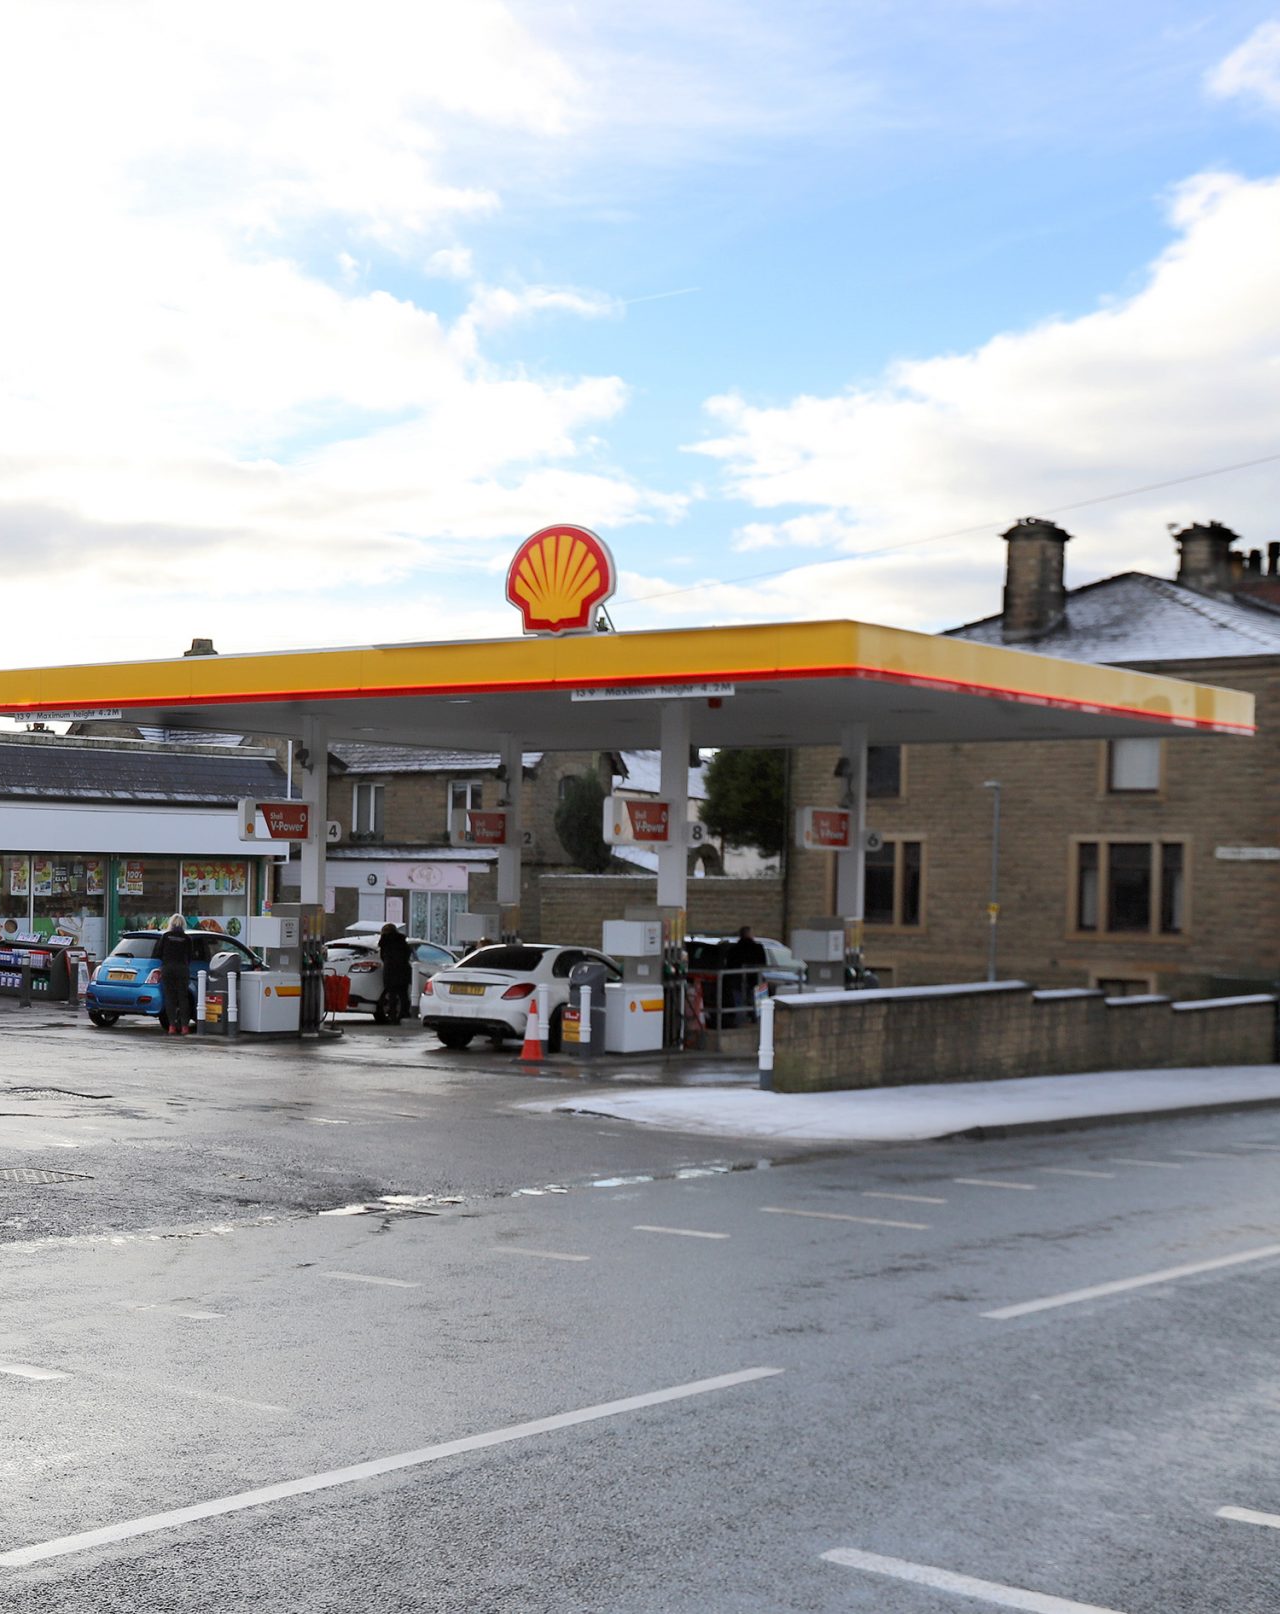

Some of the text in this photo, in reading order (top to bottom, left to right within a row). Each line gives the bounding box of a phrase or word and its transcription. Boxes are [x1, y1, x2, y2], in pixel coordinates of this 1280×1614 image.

[605, 686, 656, 697] Maximum
[660, 683, 693, 696] height
[36, 710, 68, 720] Maximum
[73, 708, 95, 720] height
[270, 811, 284, 820] Shell
[270, 820, 304, 832] V-Power
[329, 824, 338, 838] 4
[523, 831, 532, 844] 2
[692, 825, 704, 841] 8
[867, 833, 879, 848] 6
